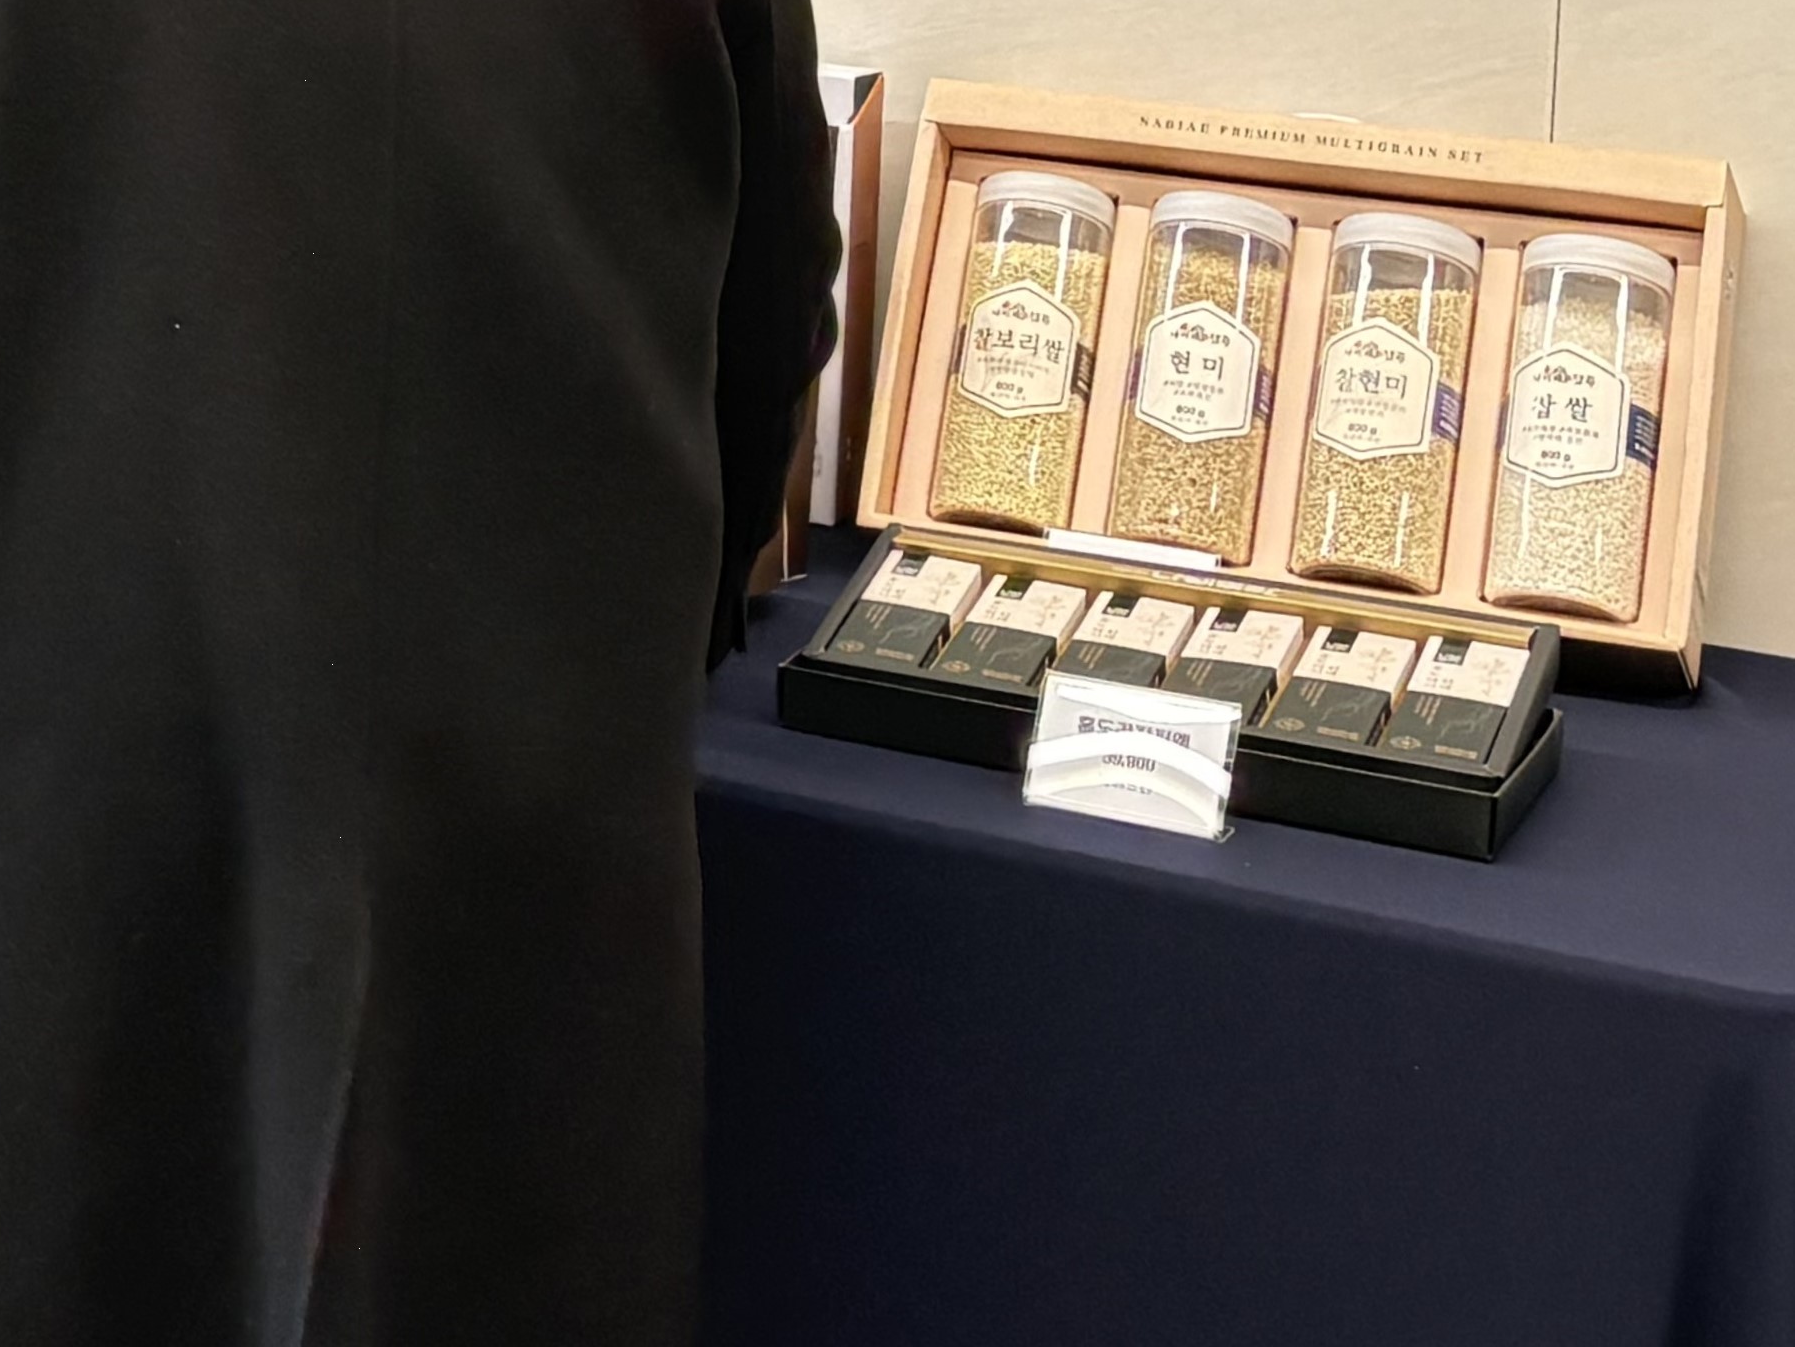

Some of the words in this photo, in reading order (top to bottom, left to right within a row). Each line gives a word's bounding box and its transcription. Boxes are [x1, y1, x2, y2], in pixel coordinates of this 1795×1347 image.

[1219, 126, 1306, 145] PREMIUM
[1315, 134, 1438, 158] MULTIGRAIN
[1447, 147, 1484, 164] SET
[973, 326, 1065, 365] 찰보리쌀
[1170, 350, 1225, 381] 현미
[1335, 367, 1408, 400] 찰현미
